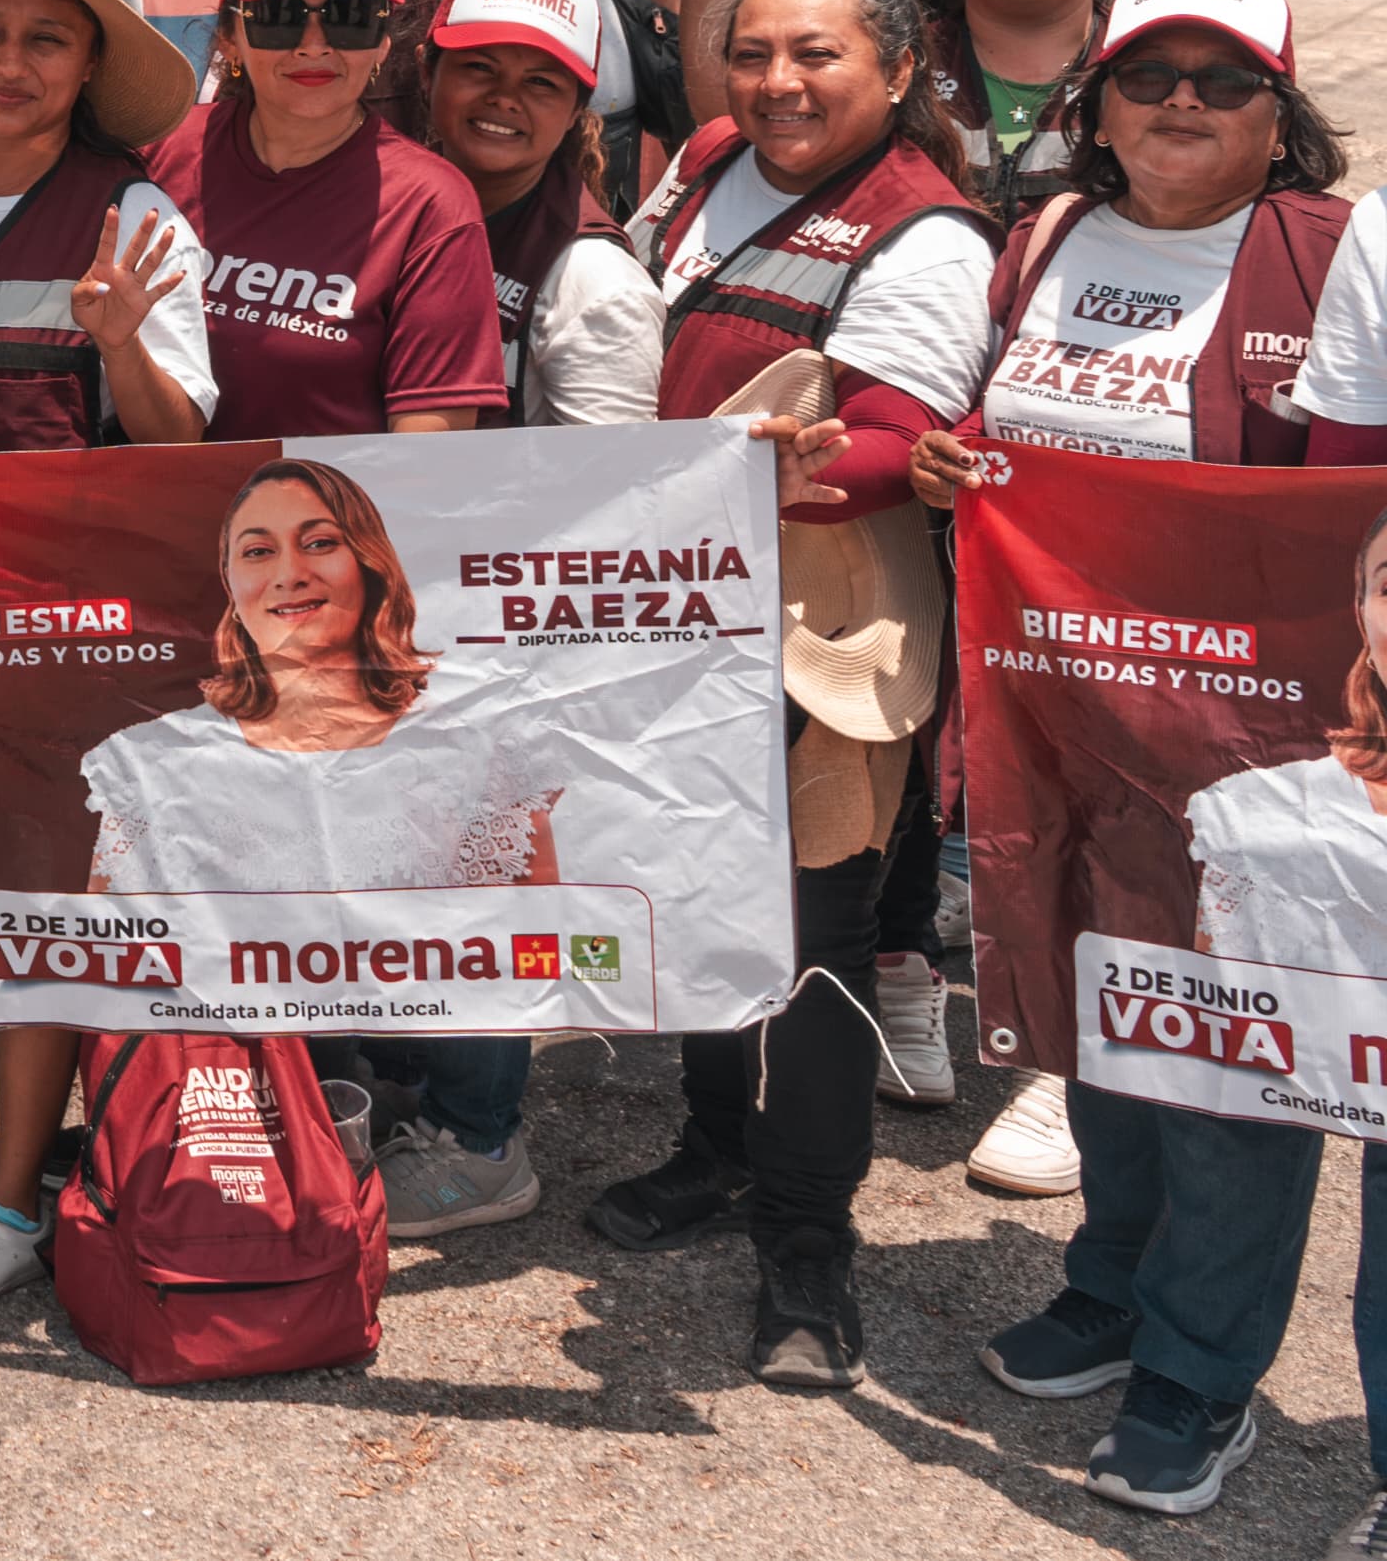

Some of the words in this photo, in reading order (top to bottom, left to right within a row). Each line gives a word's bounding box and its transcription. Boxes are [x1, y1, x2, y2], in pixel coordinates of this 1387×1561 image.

[1084, 283, 1095, 295] 2
[1099, 286, 1122, 300] DE
[1126, 291, 1181, 306] JUNIO
[234, 304, 260, 323] de
[265, 311, 348, 342] México
[1082, 297, 1174, 330] VOTA
[1009, 338, 1190, 384] ESTEFANÍ
[1008, 361, 1172, 407] BAEZA
[1008, 385, 1071, 404] DIPUTADA
[1077, 398, 1106, 408] LOC.
[1110, 400, 1146, 413] DTTO
[1033, 423, 1077, 435] HACIENDO
[1079, 430, 1120, 443] HISTORIA
[1121, 436, 1133, 445] EN
[1136, 439, 1187, 454] YUCATÁN
[459, 537, 751, 587] ESTEFANÍA
[501, 591, 719, 632] BAEZA
[518, 630, 604, 647] DIPUTADA
[607, 631, 645, 644] LOC.
[650, 630, 694, 642] DTTO
[699, 630, 710, 641] 4
[1022, 608, 1252, 660] BIENESTAR
[51, 645, 68, 664] Y
[77, 641, 176, 665] TODOS
[984, 647, 1052, 676] PARA
[1057, 656, 1156, 687] TODAS
[1167, 668, 1186, 689] Y
[1195, 670, 1304, 702] TODOS
[0, 912, 17, 932] 2
[26, 914, 66, 935] DE
[75, 916, 169, 939] JUNIO
[229, 936, 501, 985] morena
[518, 951, 556, 977] PT
[1105, 963, 1120, 987] 2
[1130, 967, 1174, 996] DE
[1182, 976, 1278, 1016] JUNIO
[149, 1001, 259, 1021] Candidata
[265, 1006, 277, 1019] a
[284, 1000, 383, 1022] Diputada
[390, 999, 452, 1018] Local.
[1102, 992, 1289, 1070] VOTA
[182, 1110, 265, 1125] PRESIDENTA
[1261, 1088, 1385, 1126] Candidata
[197, 1145, 223, 1153] AMOR
[227, 1145, 235, 1153] AL
[236, 1145, 267, 1154] PUEBLO
[211, 1169, 266, 1182] morena
